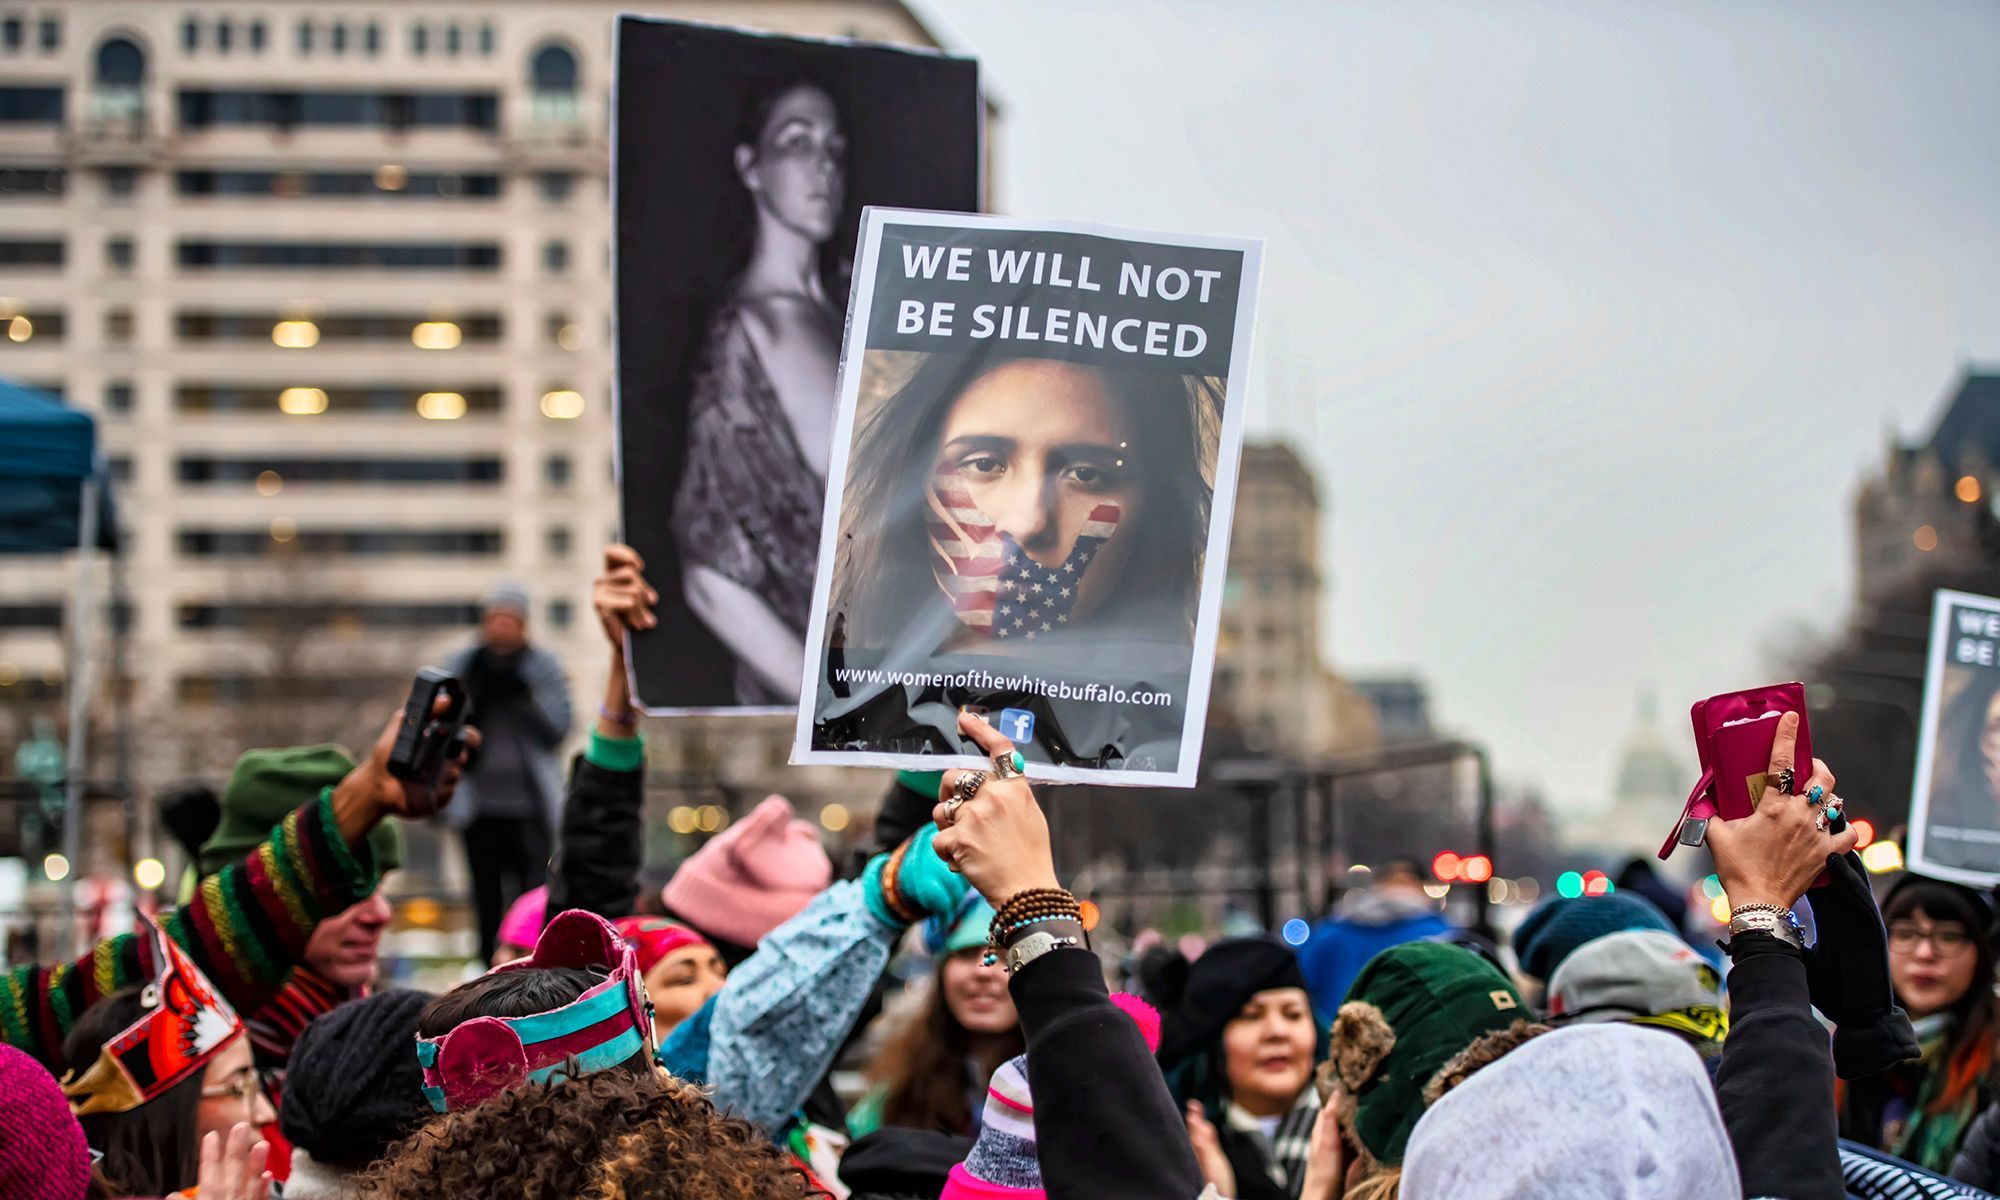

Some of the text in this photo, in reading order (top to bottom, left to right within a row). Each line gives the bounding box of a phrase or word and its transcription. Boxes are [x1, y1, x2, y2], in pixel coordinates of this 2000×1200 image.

[901, 244, 1222, 303] WE WILL NOT
[896, 299, 1208, 358] BE SILENCED
[835, 667, 1172, 706] www.womenofthewhitebuffalo.com
